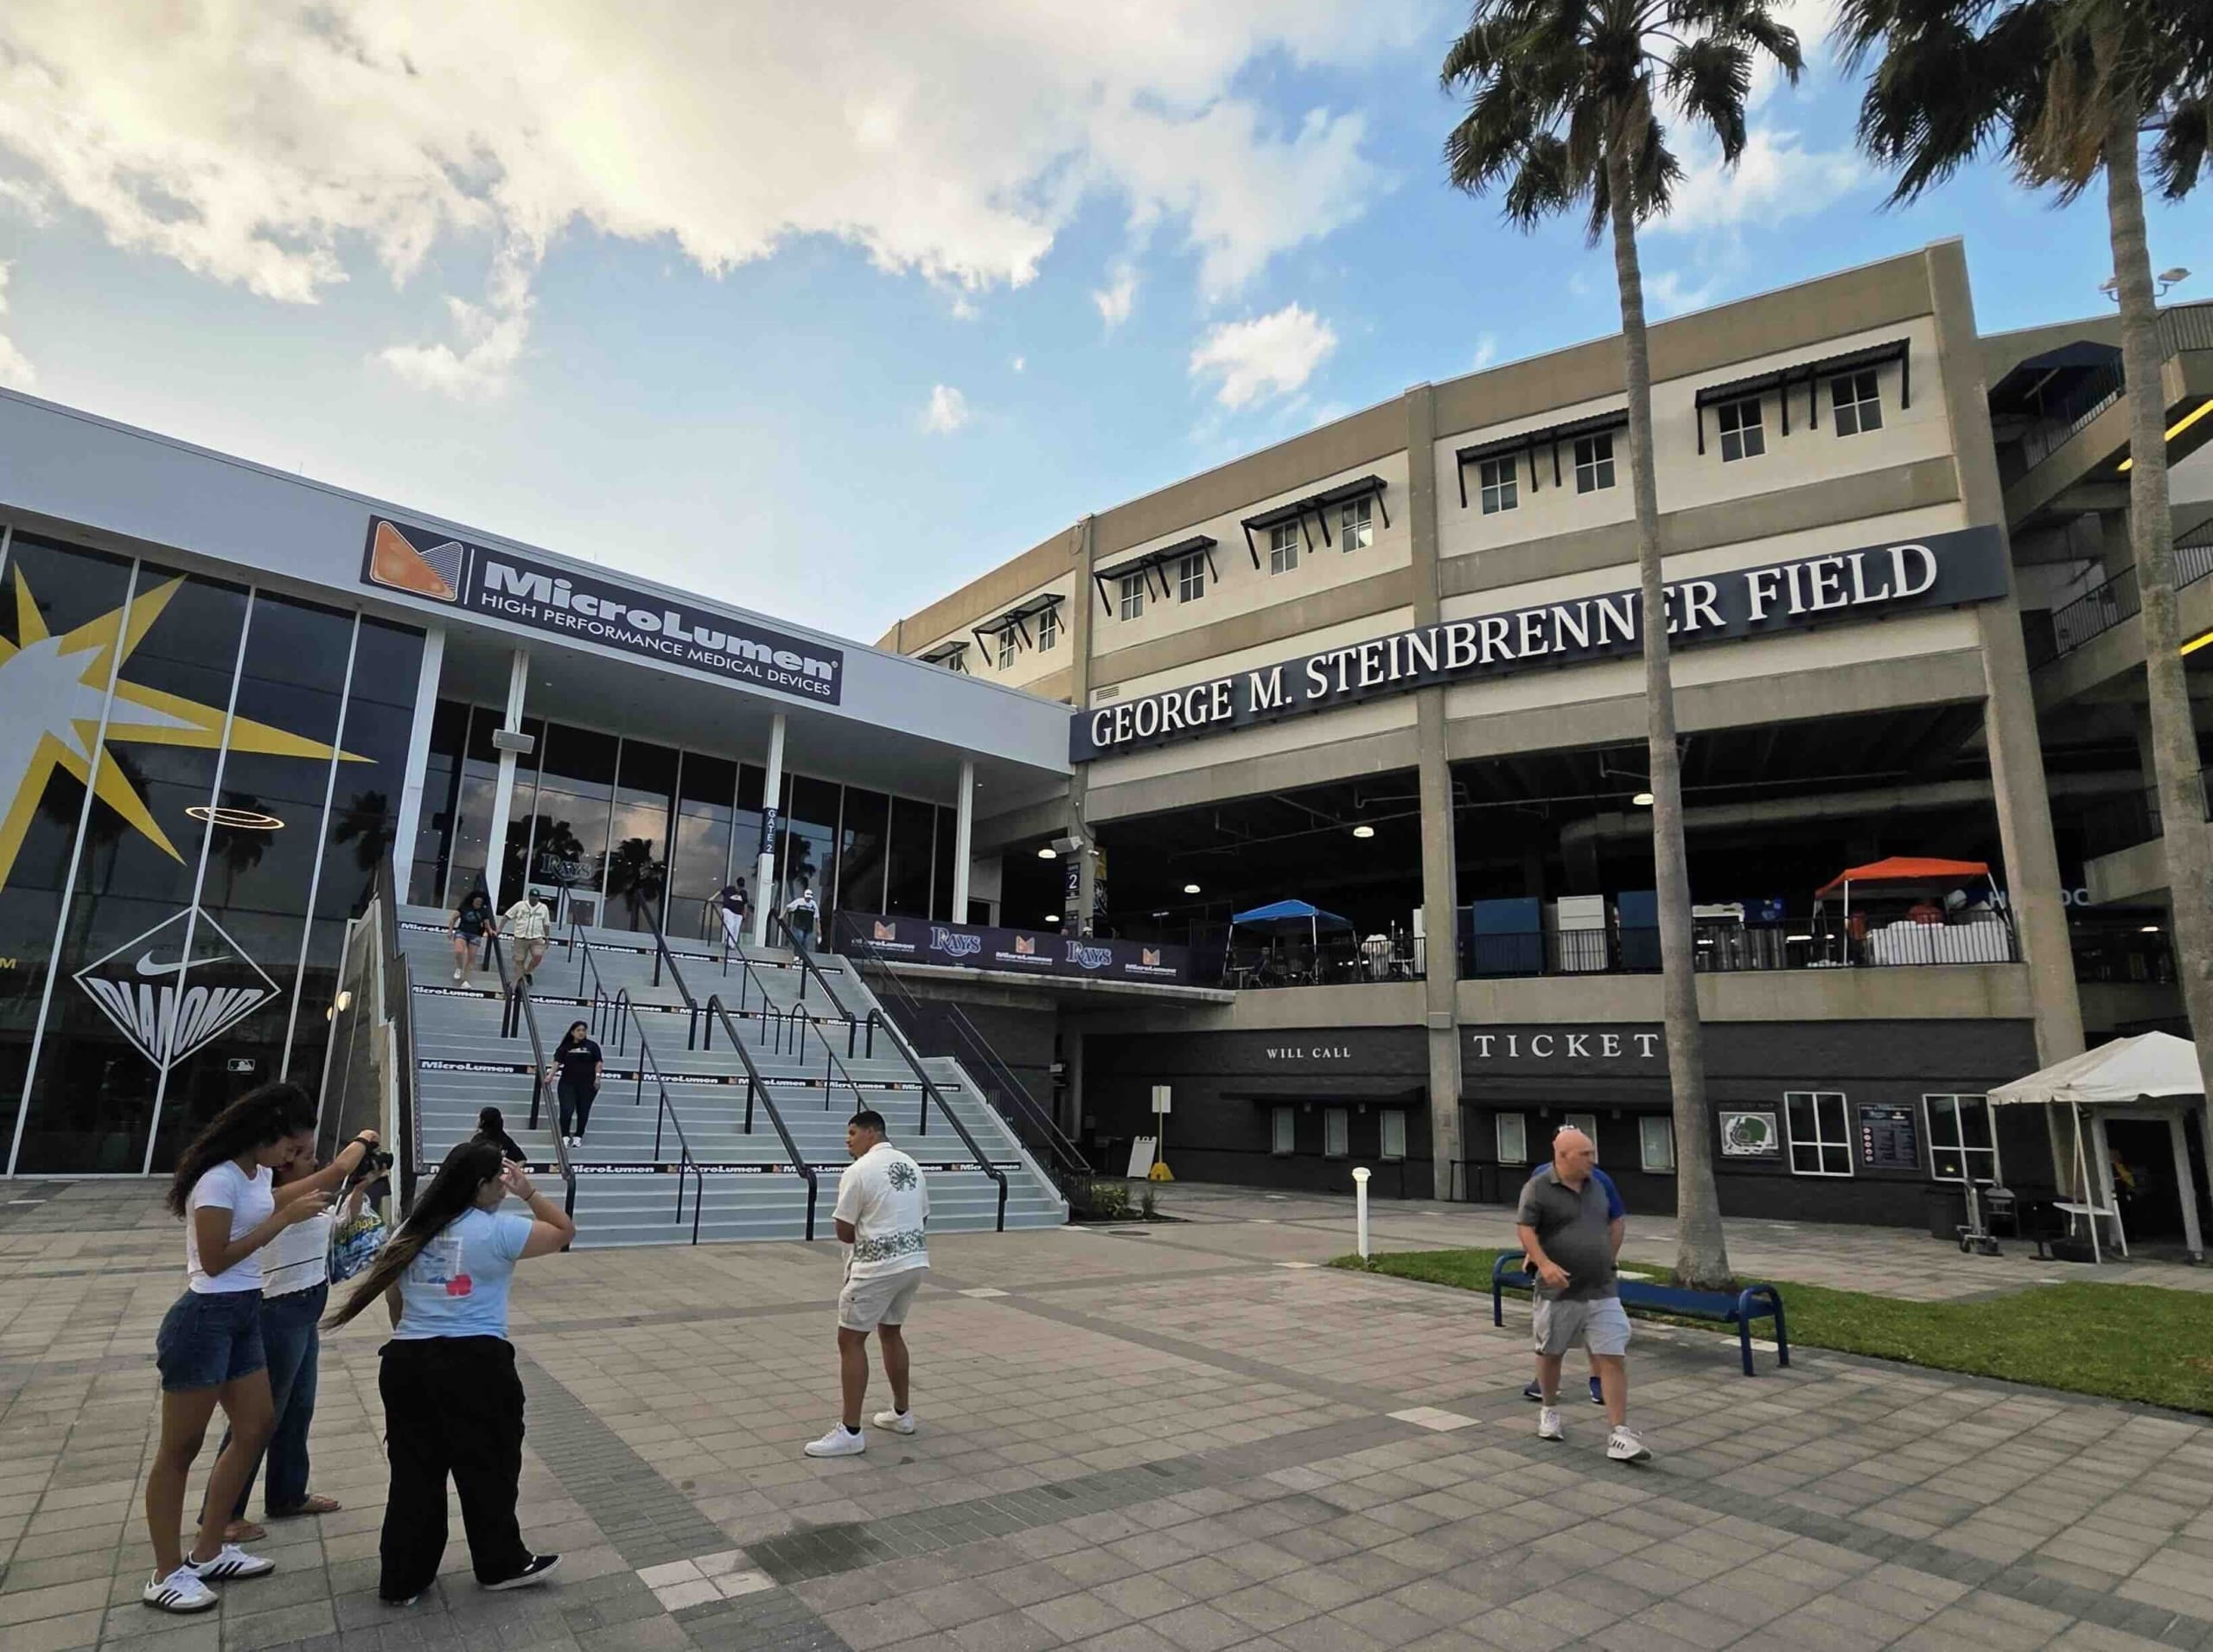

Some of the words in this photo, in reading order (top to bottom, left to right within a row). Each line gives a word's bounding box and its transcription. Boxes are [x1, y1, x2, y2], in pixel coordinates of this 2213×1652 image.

[482, 592, 536, 618] HIGH
[544, 609, 683, 657] PERFORMANCE
[687, 647, 763, 679] MEDICAL
[767, 668, 832, 696] DEVICES
[1091, 679, 1234, 747] GEORGE
[1249, 667, 1293, 712] M.
[1744, 543, 1938, 622] FIELD
[767, 809, 776, 842] GATE
[767, 844, 774, 852] 2
[1068, 873, 1078, 890] 2
[86, 977, 265, 1061] DIAMOND
[1266, 1048, 1304, 1060] WILL
[1312, 1047, 1351, 1059] CALL
[421, 1061, 513, 1074] MicroLumen
